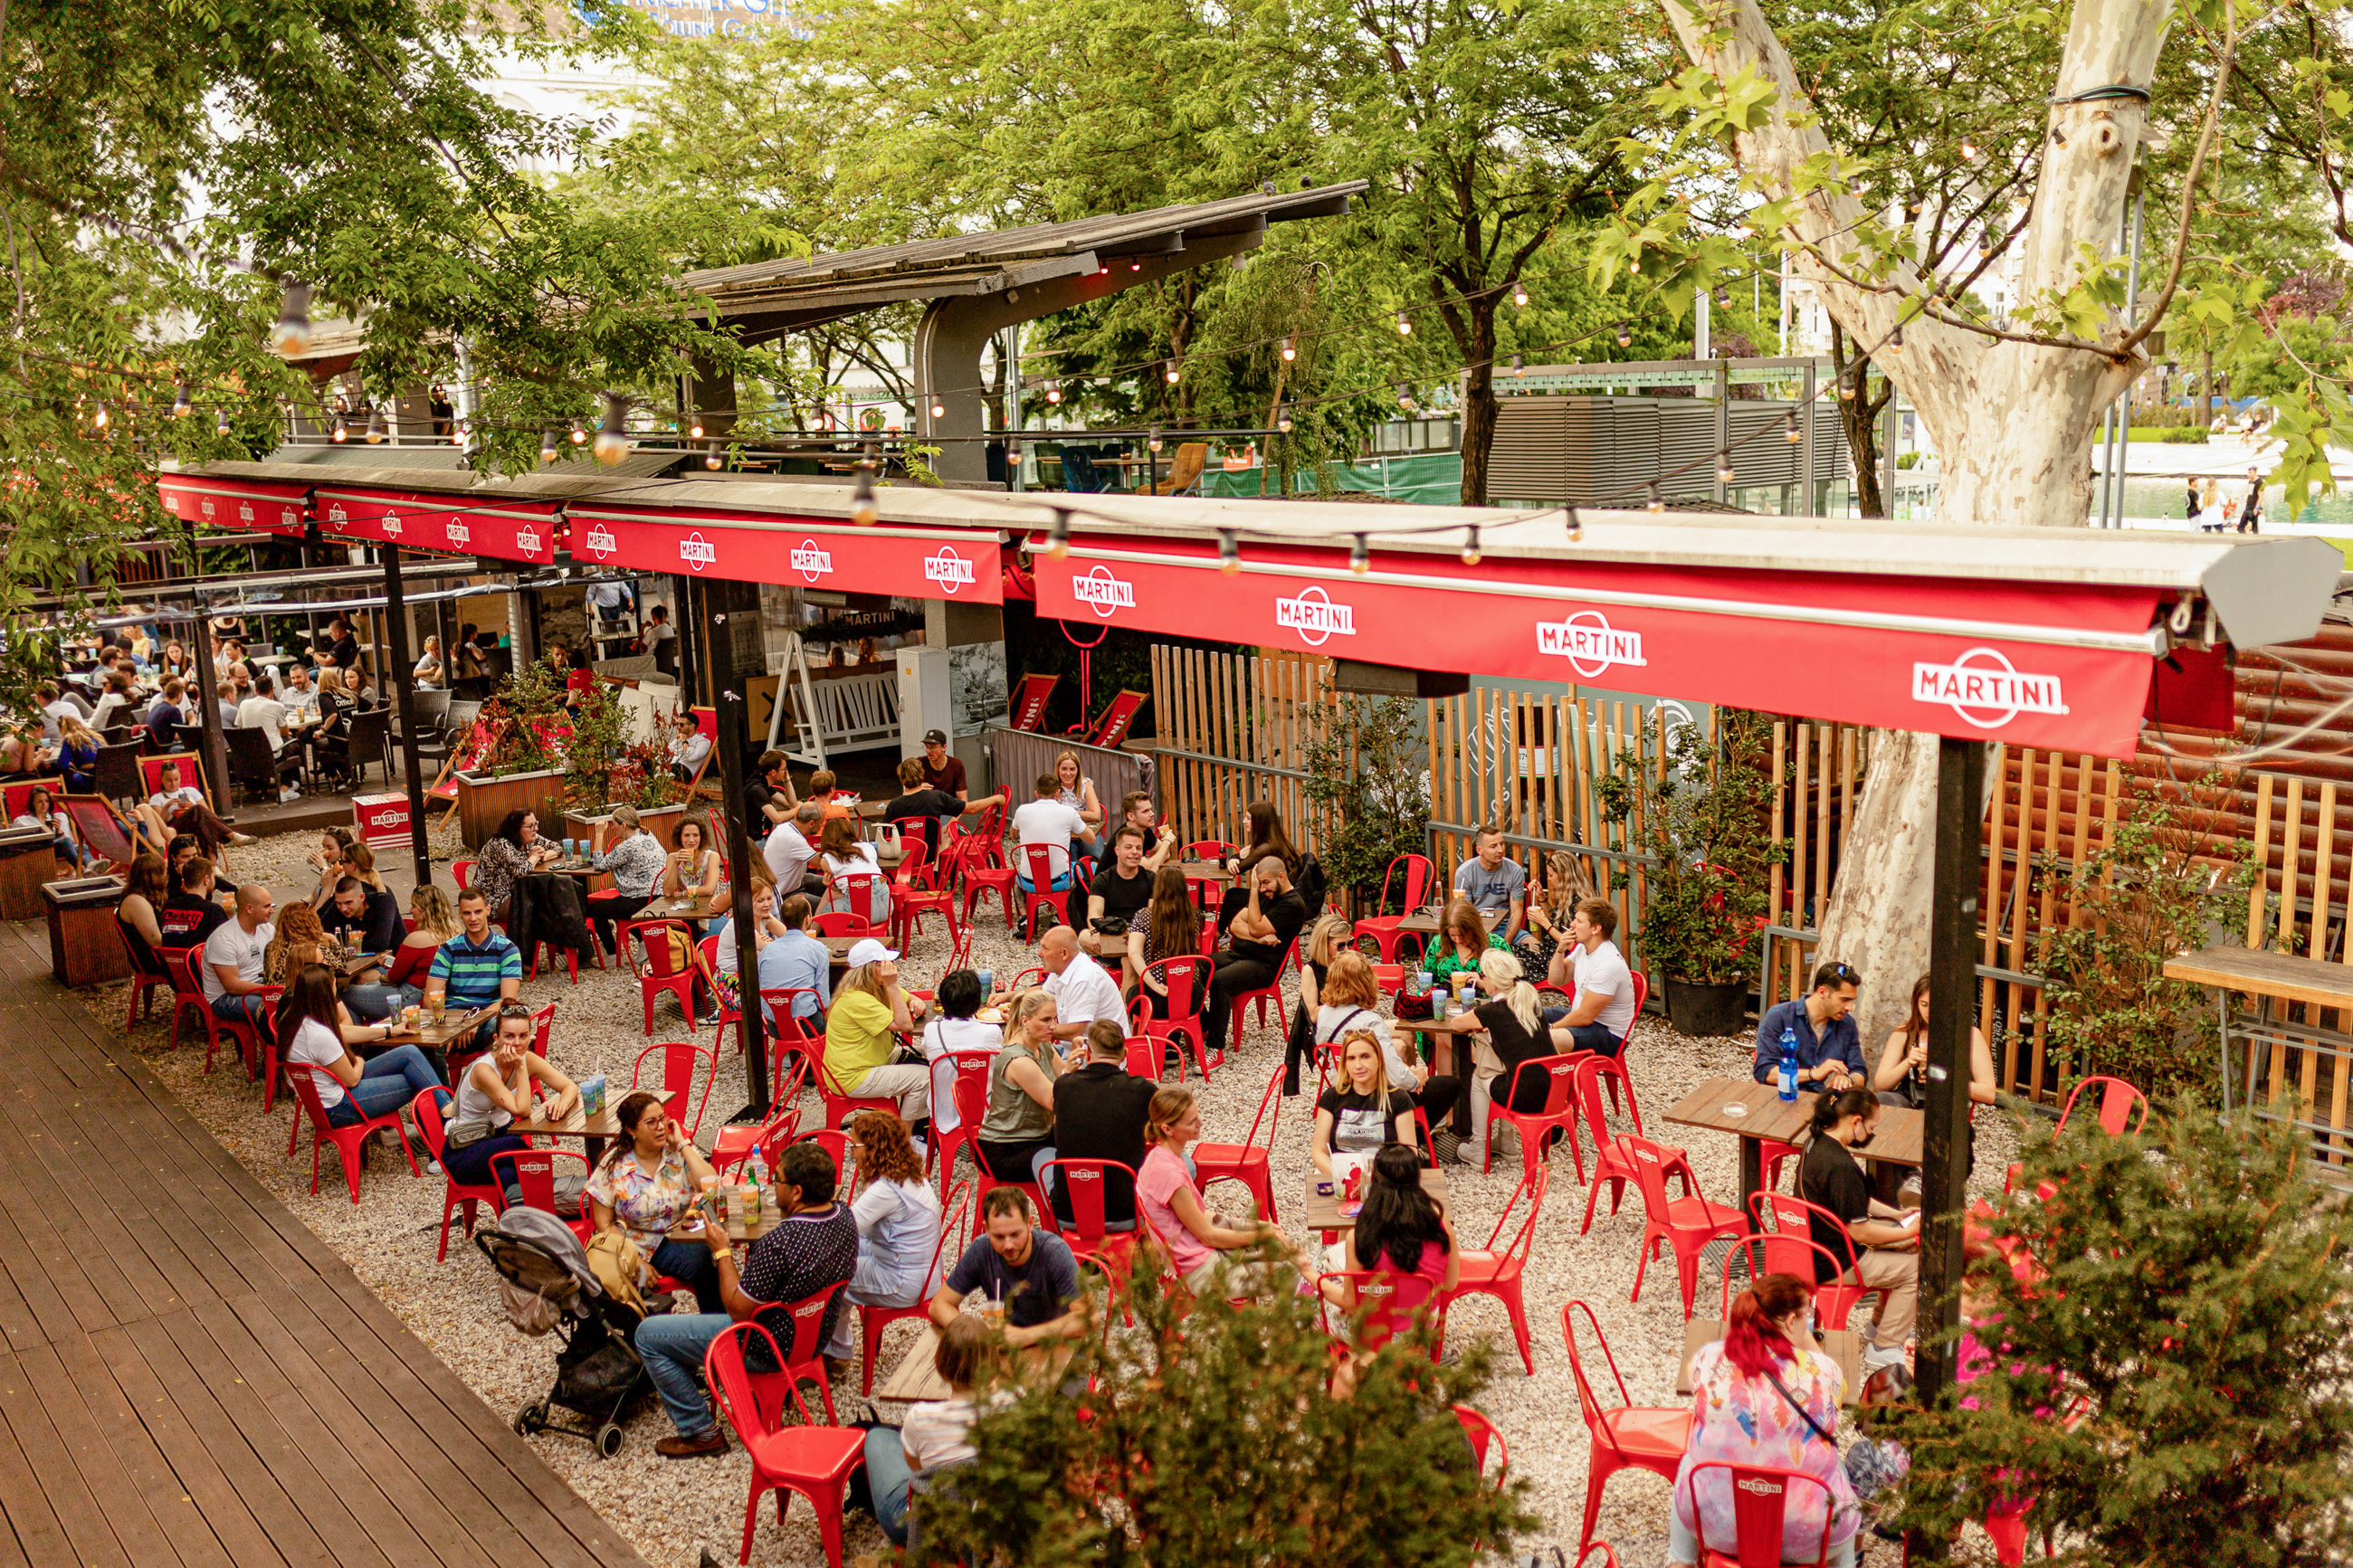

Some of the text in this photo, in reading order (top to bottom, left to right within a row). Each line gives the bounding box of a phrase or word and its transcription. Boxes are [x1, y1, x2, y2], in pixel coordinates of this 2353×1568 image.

[384, 518, 401, 531] MARTINI
[448, 525, 469, 540] MARTINI
[519, 534, 540, 549] MARTINI
[588, 534, 615, 550] MARTINI
[681, 544, 714, 560] MARTINI
[794, 552, 830, 570] MARTINI
[928, 560, 971, 580] MARTINI
[1076, 580, 1130, 603] MARTINI
[845, 610, 895, 626] MARTINI
[1281, 603, 1348, 630] MARTINI
[1543, 628, 1634, 660] MARTINI
[1920, 670, 2053, 707] MARTINI
[336, 698, 354, 707] Office
[373, 813, 406, 824] MARTINI
[1552, 1065, 1573, 1074] MARTINI
[772, 1127, 788, 1143] MARTINI
[1635, 1150, 1657, 1163] MARTINI
[1778, 1213, 1805, 1225] MARTINI
[1358, 1286, 1392, 1294] MARTINI
[795, 1301, 824, 1317] MARTINI
[1737, 1481, 1781, 1493] MARTINI
